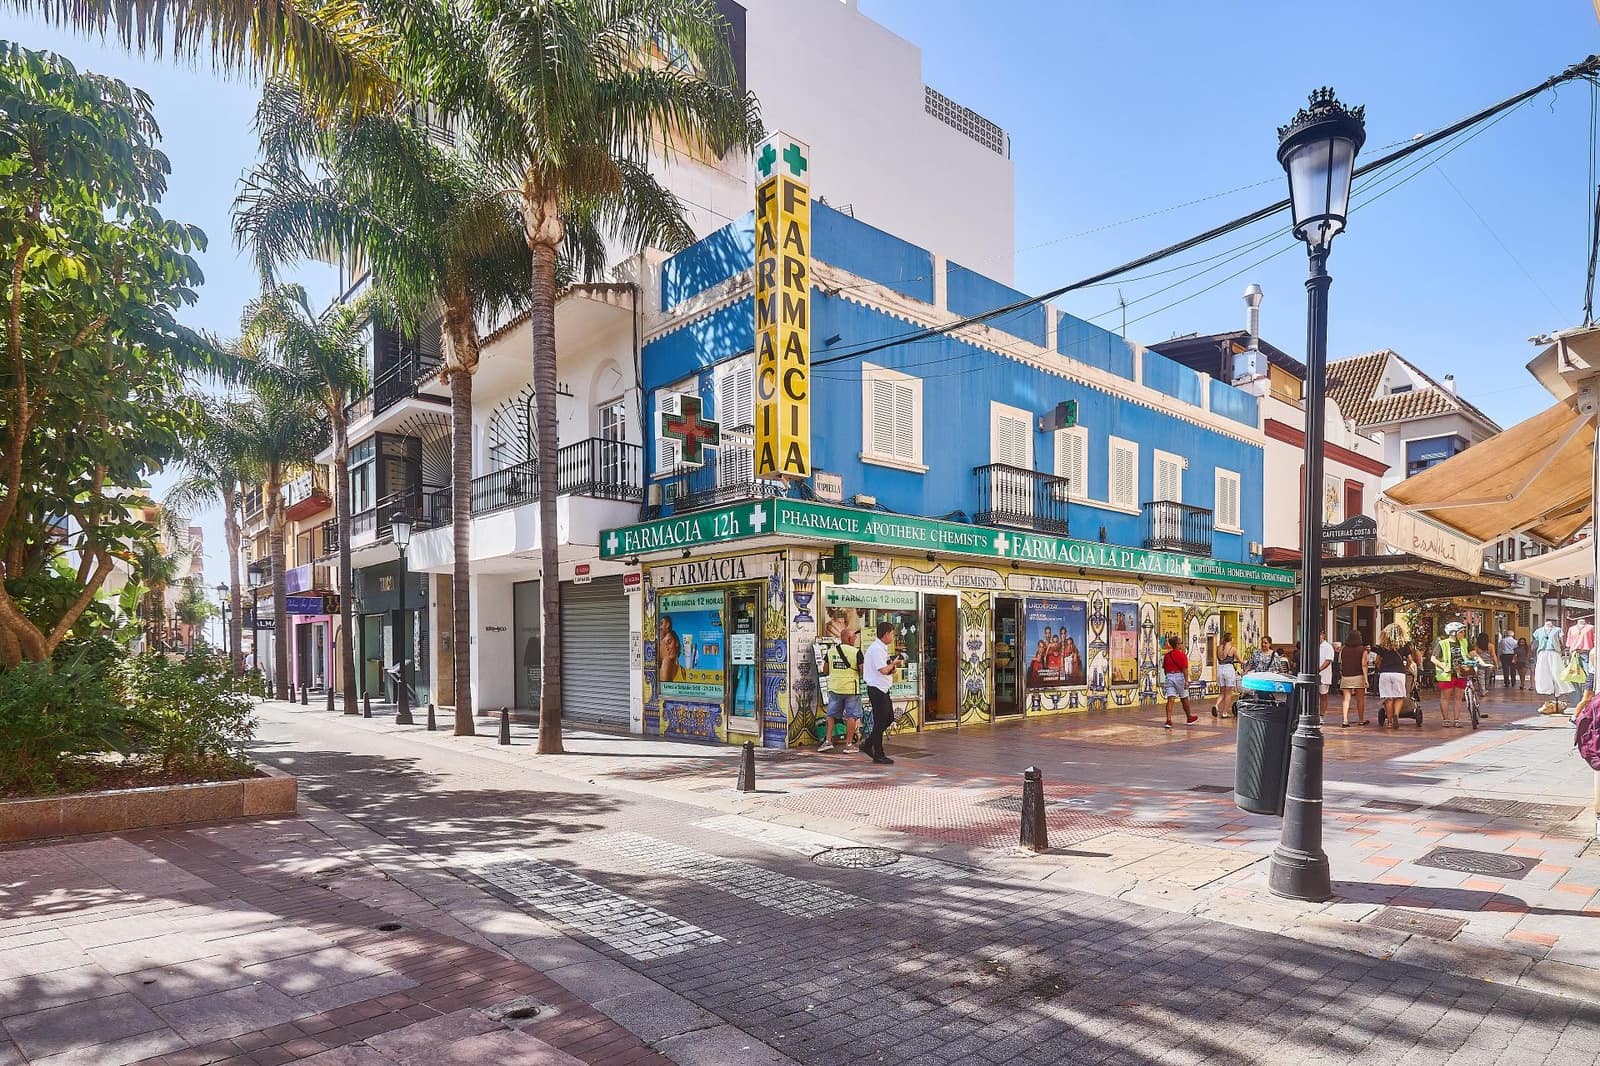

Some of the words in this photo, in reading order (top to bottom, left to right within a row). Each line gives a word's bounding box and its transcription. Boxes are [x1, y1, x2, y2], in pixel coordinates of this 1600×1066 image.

[757, 179, 775, 475] FARMACIA
[783, 179, 807, 475] FARMACIA
[624, 519, 702, 551] FARMACIA
[713, 511, 740, 538] 12h
[781, 509, 859, 533] PHARMACIE
[864, 521, 926, 541] APOTHEKE
[930, 529, 988, 548] CHEMIST'S
[1354, 528, 1371, 536] COSTA
[1013, 536, 1096, 566] FARMACIA
[1100, 549, 1117, 567] LA
[1121, 551, 1162, 572] PLAZA
[1165, 557, 1182, 575] 12h
[669, 557, 747, 586] FARMACIA
[895, 573, 945, 588] APOTHEKE
[1030, 577, 1079, 594] FARMACIA
[697, 597, 705, 605] 12
[841, 594, 878, 603] FARMACIA
[880, 595, 890, 604] 12
[891, 596, 914, 605] HORAS
